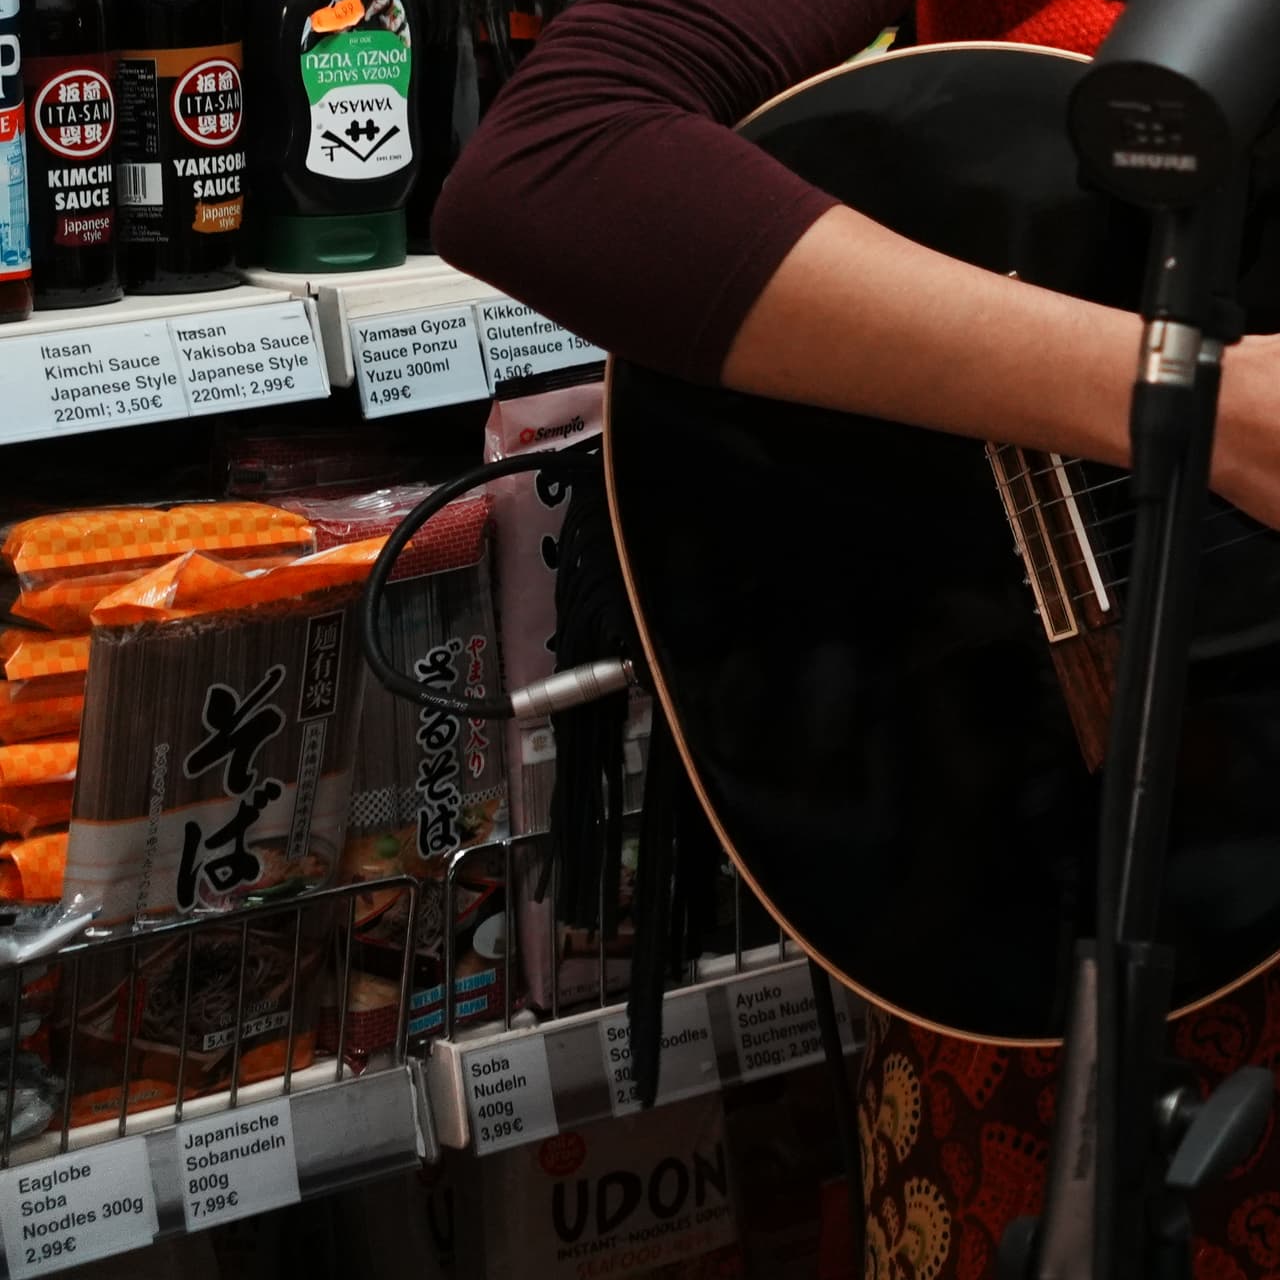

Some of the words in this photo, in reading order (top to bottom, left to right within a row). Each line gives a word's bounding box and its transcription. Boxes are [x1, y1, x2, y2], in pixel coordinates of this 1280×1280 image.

[305, 52, 351, 70] YUZU
[356, 47, 408, 67] PONZU
[317, 68, 359, 84] SAUCE
[362, 67, 400, 81] GYOZA
[48, 100, 110, 125] ITA-SAN
[186, 91, 240, 115] ITA-SAN
[328, 97, 393, 115] YAMASA
[48, 164, 112, 188] KIMCHI
[173, 151, 246, 177] YAKISOBA
[55, 188, 110, 211] SAUCE
[193, 175, 241, 199] SAUCE
[83, 229, 102, 244] style
[359, 324, 417, 345] Yamasa
[421, 315, 467, 336] Gyoza
[41, 343, 92, 360] Itasan
[183, 340, 257, 363] Yakisoba
[260, 333, 310, 352] Sauce
[362, 346, 409, 365] Sauce
[412, 338, 458, 357] Ponzu
[489, 336, 564, 362] Sojasauce
[45, 360, 104, 381] Kimchi
[108, 354, 161, 371] Sauce
[188, 361, 266, 384] Japanese
[268, 352, 310, 373] Style
[366, 368, 402, 385] Yuzu
[406, 358, 450, 378] 300ml
[51, 378, 132, 403] Japanese
[135, 372, 178, 392] Style
[191, 384, 247, 405] 220ml;
[250, 375, 296, 396] 2,99€
[369, 384, 412, 406] 4,99€
[55, 402, 113, 423] 220ml;
[116, 394, 163, 416] 3,50€
[533, 415, 585, 442] Sempio
[173, 661, 288, 914] そば
[736, 984, 783, 1009] Ayuko
[738, 1007, 777, 1029] Soba
[471, 1058, 511, 1079] Soba
[744, 1048, 787, 1071] 300g;
[474, 1073, 528, 1099] Nudeln
[478, 1099, 515, 1122] 400g
[184, 1113, 280, 1150] Japanische
[480, 1118, 524, 1142] 3,99€
[186, 1133, 286, 1172] Sobanudeln
[18, 1164, 91, 1195] Eaglobe
[188, 1172, 230, 1195] 800g
[551, 1138, 730, 1244] UDON
[21, 1193, 67, 1218] Soba
[191, 1191, 240, 1219] 7,99€
[23, 1209, 97, 1241] Noodles
[102, 1196, 144, 1220] 300g
[26, 1236, 77, 1265] 2,99€
